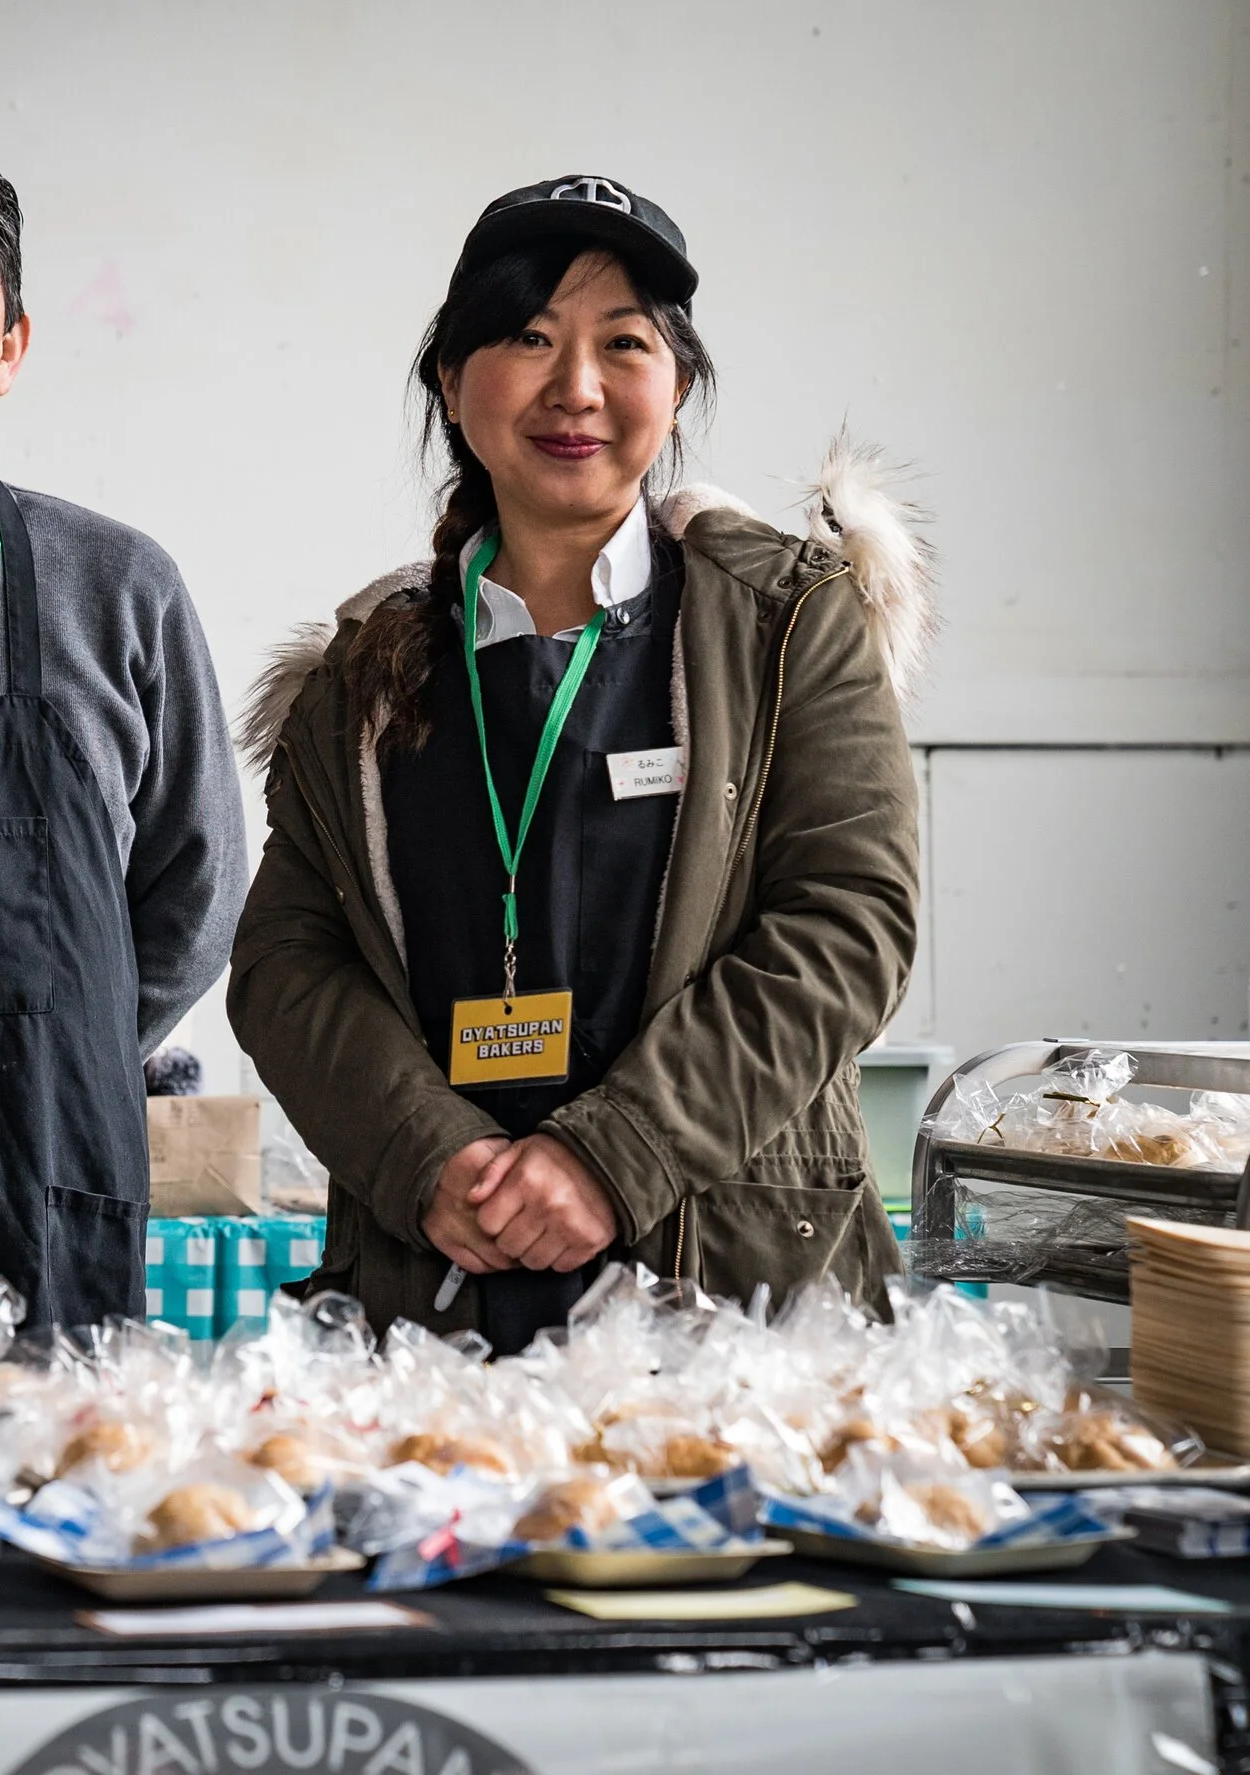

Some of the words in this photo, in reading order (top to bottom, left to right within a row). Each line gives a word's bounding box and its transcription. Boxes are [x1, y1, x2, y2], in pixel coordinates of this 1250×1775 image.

[637, 758, 664, 769] るみこ
[633, 774, 673, 787] RUMIKO
[460, 1019, 564, 1043] OYATSUPAN
[477, 1039, 545, 1059] BAKERS
[39, 1692, 518, 1775] YATSUPA
